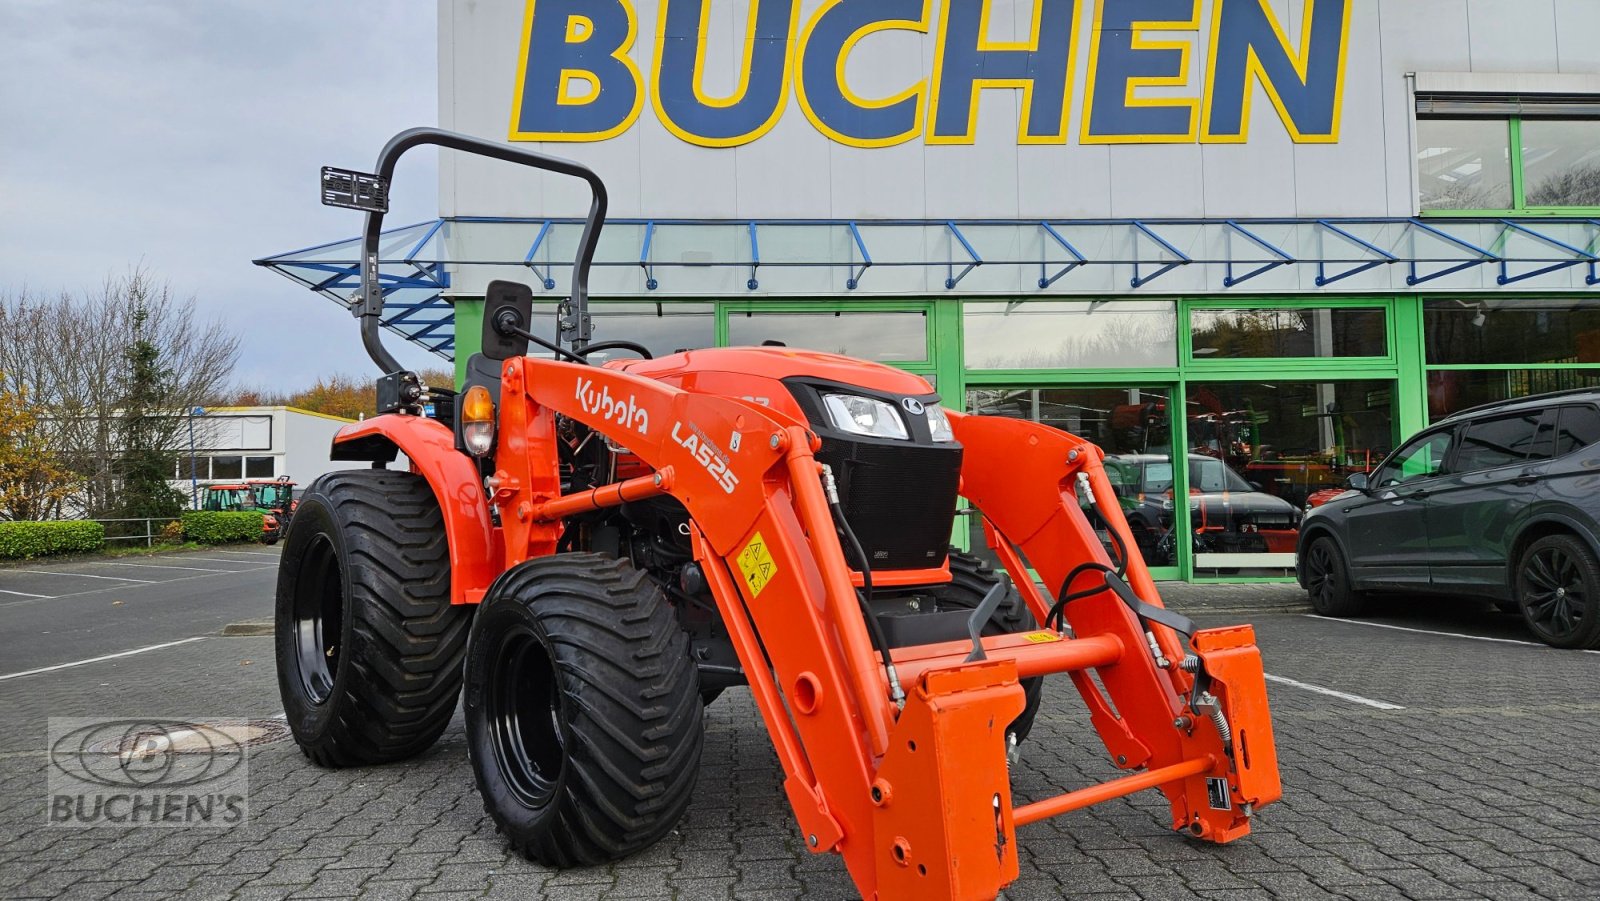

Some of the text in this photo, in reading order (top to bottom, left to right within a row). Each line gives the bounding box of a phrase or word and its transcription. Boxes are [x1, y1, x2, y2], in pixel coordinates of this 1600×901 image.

[508, 0, 1352, 148] BUCHEN
[575, 376, 649, 434] Kubota
[671, 421, 740, 494] LA525
